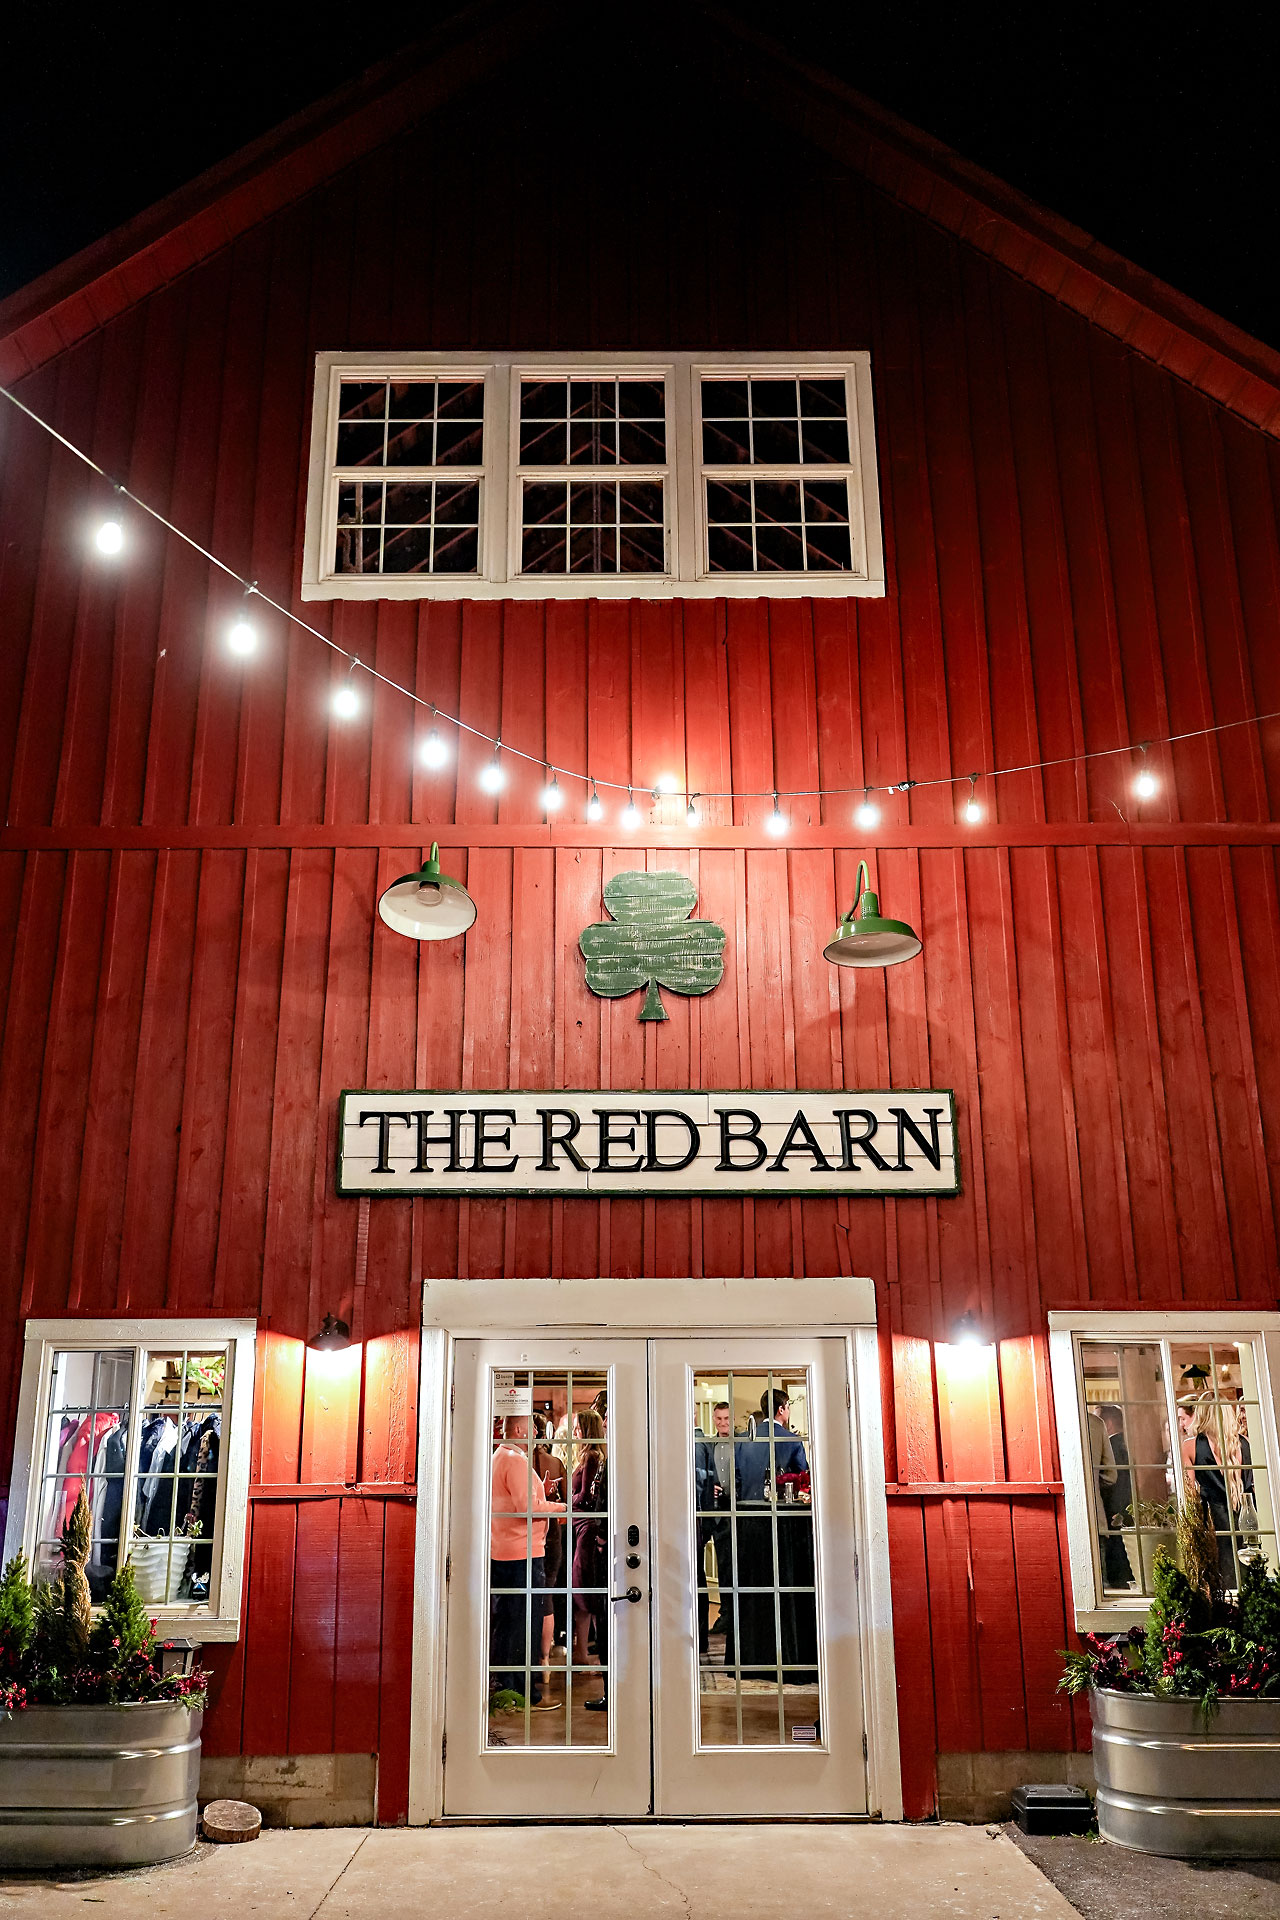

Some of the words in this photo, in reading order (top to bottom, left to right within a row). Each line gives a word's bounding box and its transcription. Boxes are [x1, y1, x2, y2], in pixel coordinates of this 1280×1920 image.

[359, 1108, 520, 1174] THE
[535, 1108, 701, 1173] RED
[714, 1108, 945, 1173] BARN
